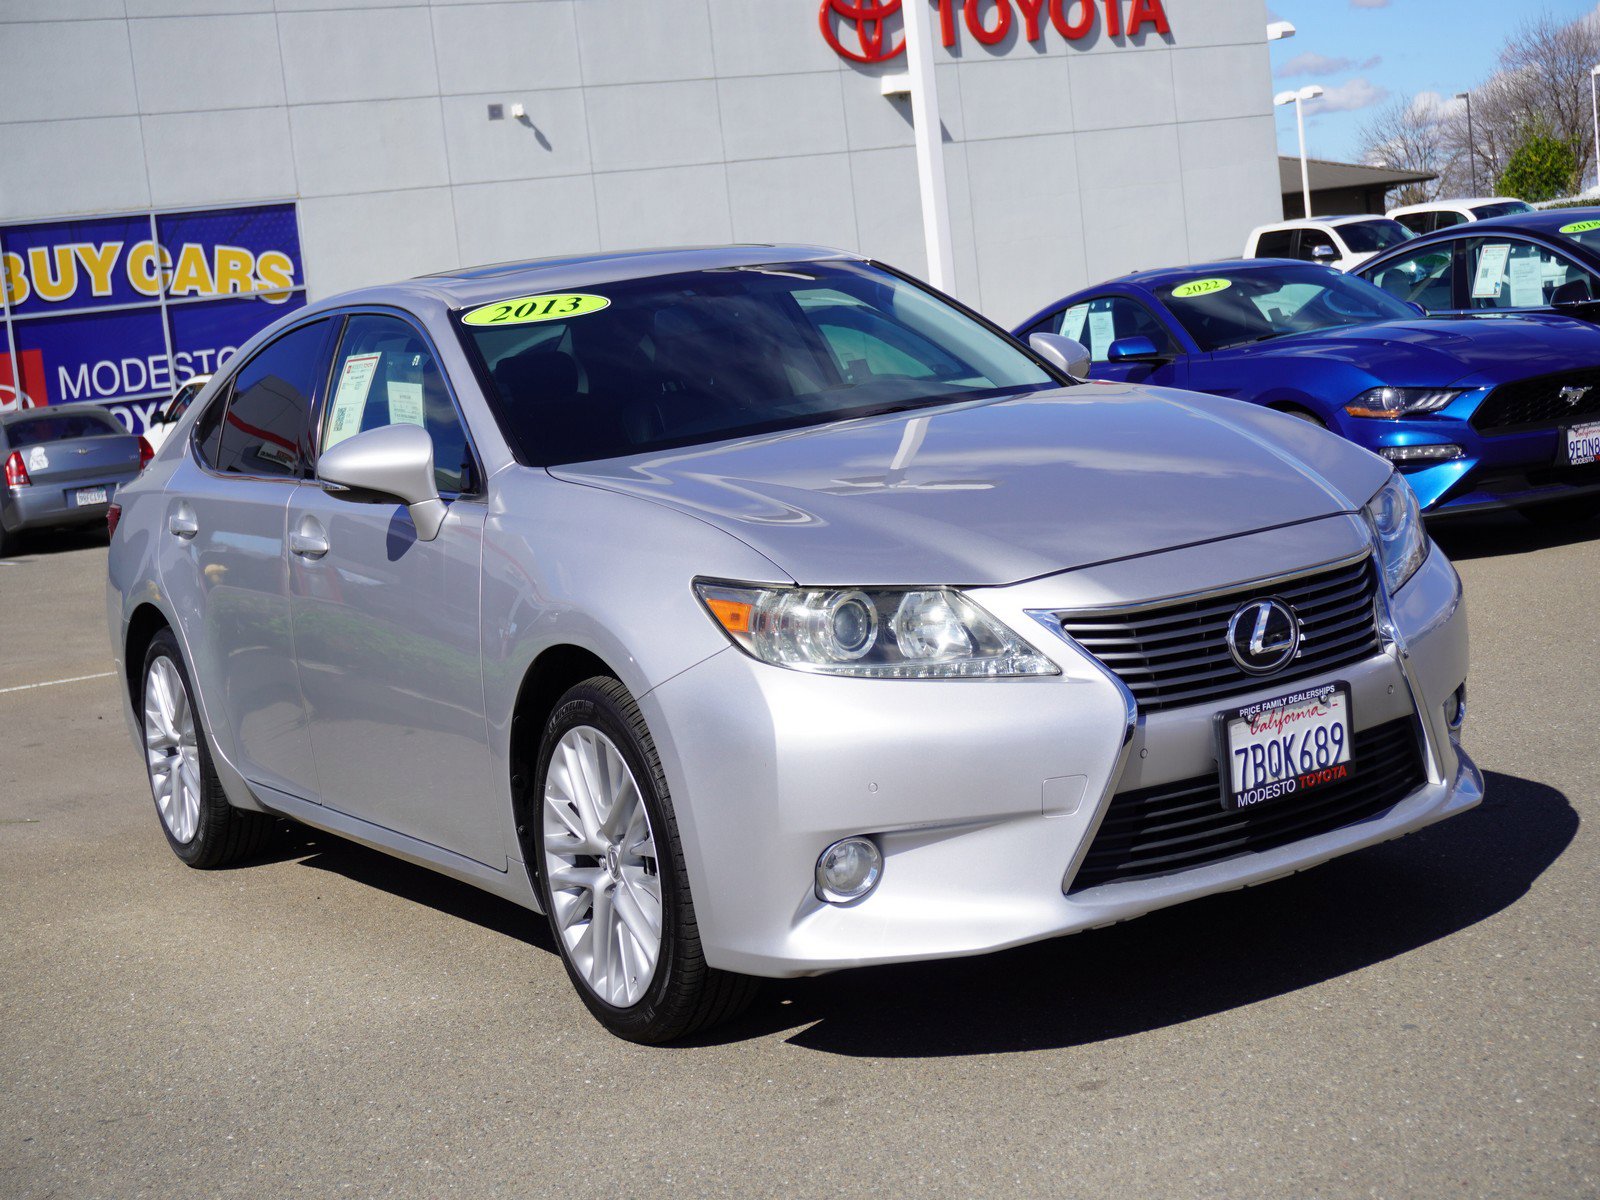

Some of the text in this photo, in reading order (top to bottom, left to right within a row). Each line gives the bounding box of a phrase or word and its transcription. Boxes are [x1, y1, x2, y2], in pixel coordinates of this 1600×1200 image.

[0, 240, 295, 308] BUY CARS
[1184, 280, 1220, 295] 2022
[489, 297, 582, 322] 2013
[1239, 685, 1335, 717] PRICE FAMILY DEALERSHIPS
[1251, 703, 1327, 735] California
[1235, 722, 1344, 790] 7BQK689
[1237, 766, 1347, 807] MODESTO TOYOTA
